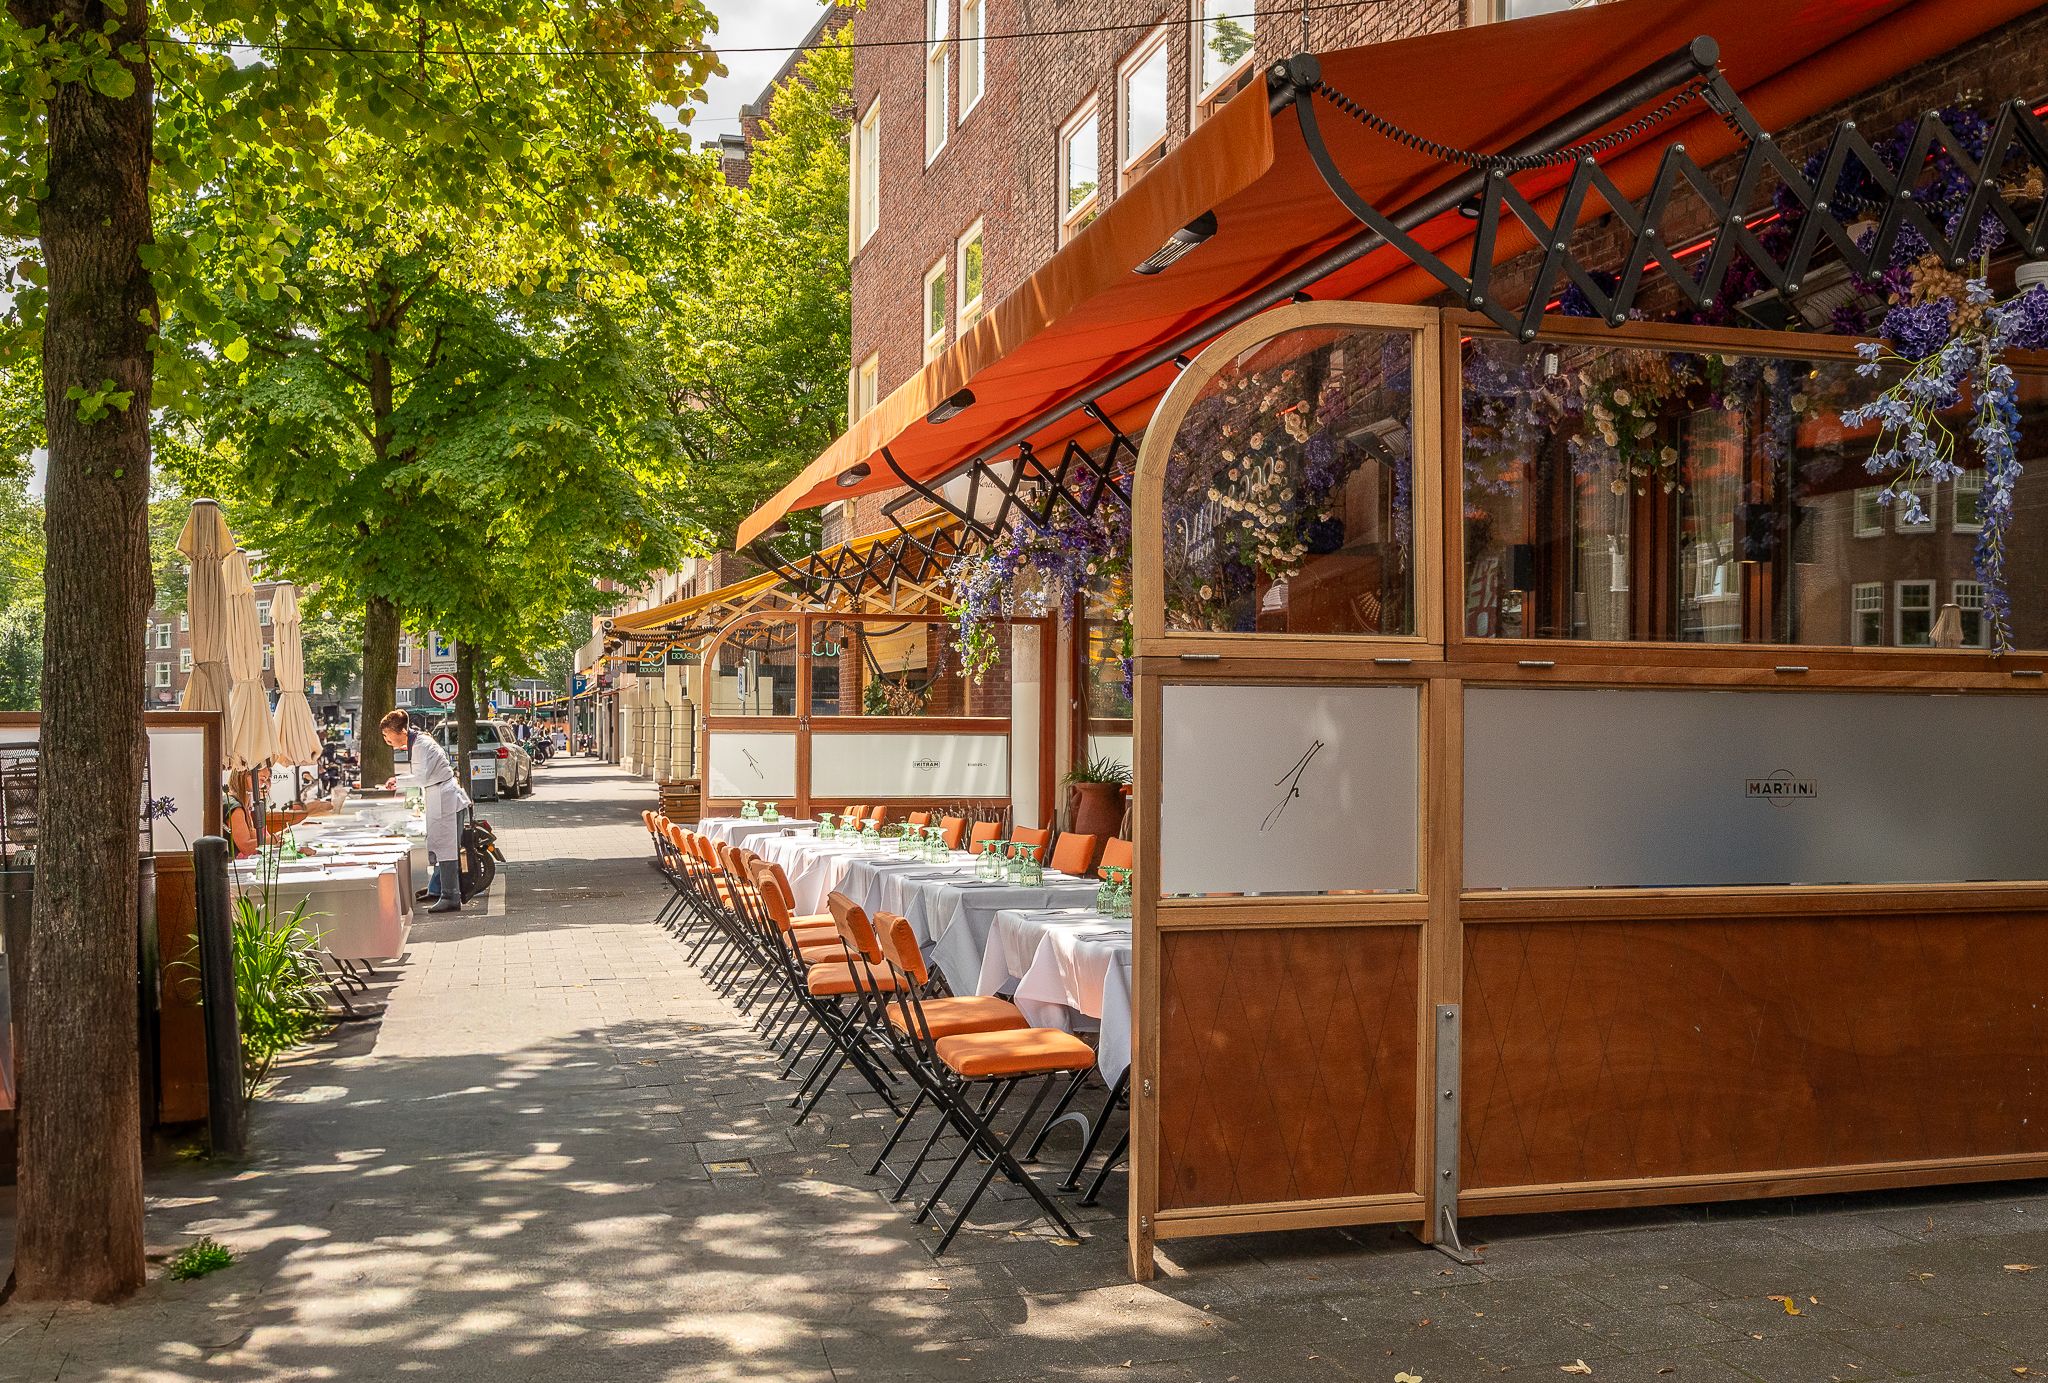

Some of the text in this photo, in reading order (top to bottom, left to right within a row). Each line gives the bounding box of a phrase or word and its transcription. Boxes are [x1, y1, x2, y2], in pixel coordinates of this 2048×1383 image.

[435, 682, 454, 693] 30
[576, 681, 582, 690] P
[1749, 782, 1813, 794] MARTINI
